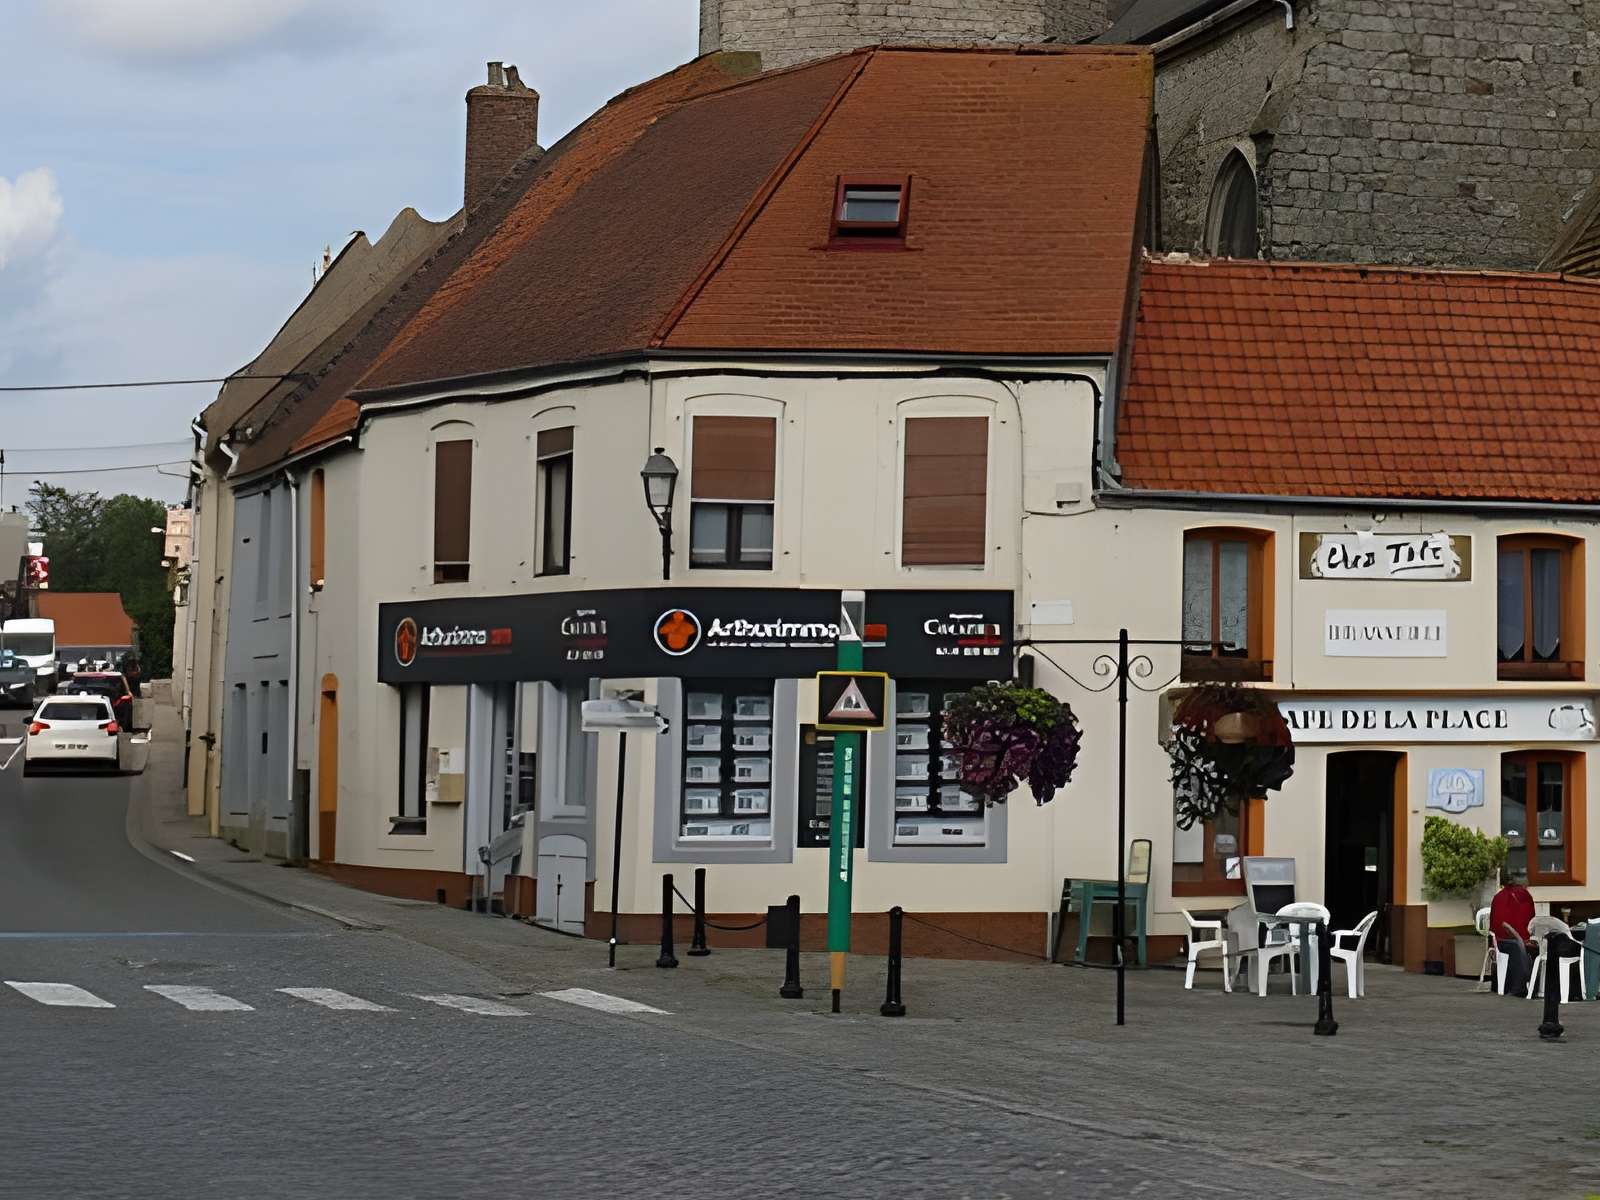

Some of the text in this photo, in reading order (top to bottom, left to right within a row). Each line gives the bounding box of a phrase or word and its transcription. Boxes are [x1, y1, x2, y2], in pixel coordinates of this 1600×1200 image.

[1341, 709, 1377, 730] DE
[1384, 709, 1418, 730] LA
[1426, 709, 1509, 730] PLACE
